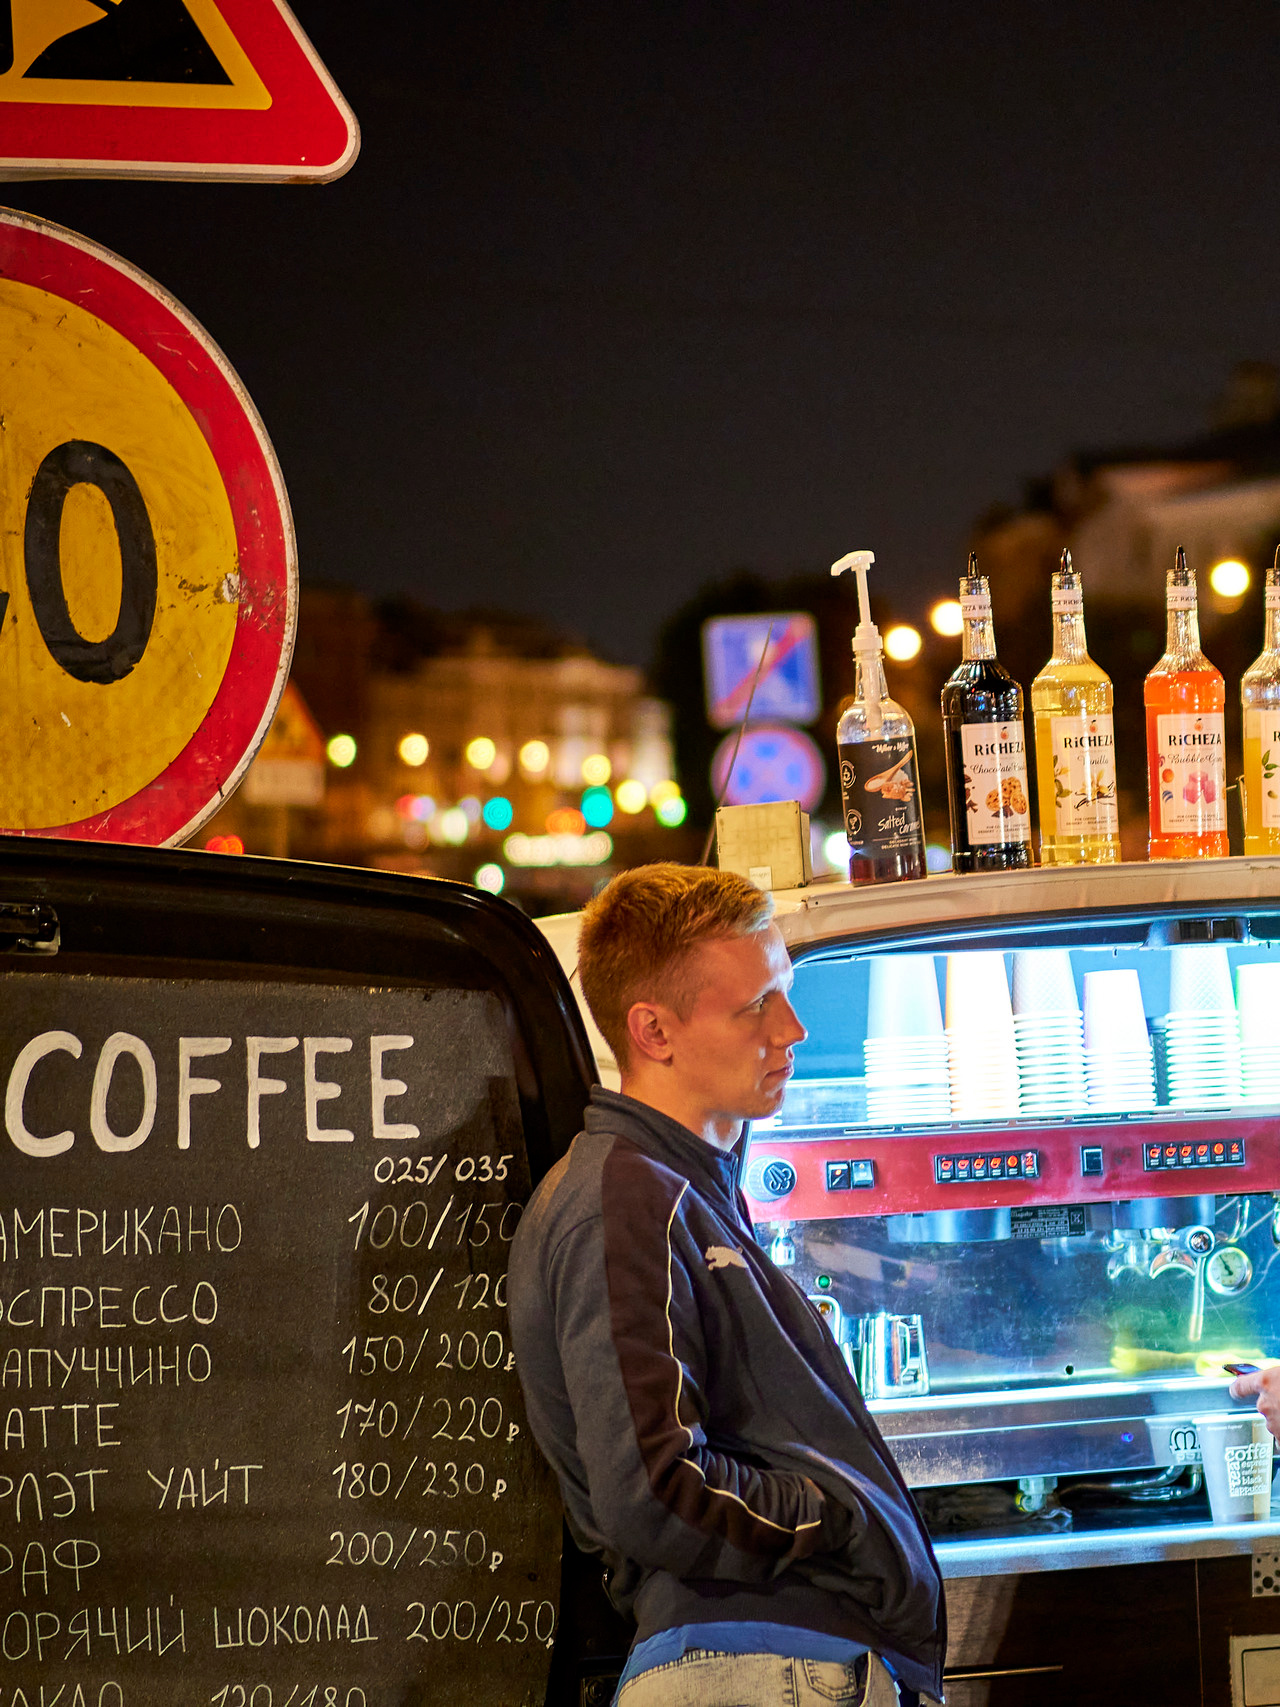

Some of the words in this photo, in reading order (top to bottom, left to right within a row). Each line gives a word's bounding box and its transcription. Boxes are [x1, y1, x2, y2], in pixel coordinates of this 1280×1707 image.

[0, 440, 158, 684] 0
[1077, 754, 1109, 766] Vnilla
[5, 1030, 420, 1157] COFFEE
[0, 1281, 218, 1328] СПРЕССО
[147, 1458, 263, 1509] УАЙТ
[214, 1604, 379, 1649] ШОКОЛАД
